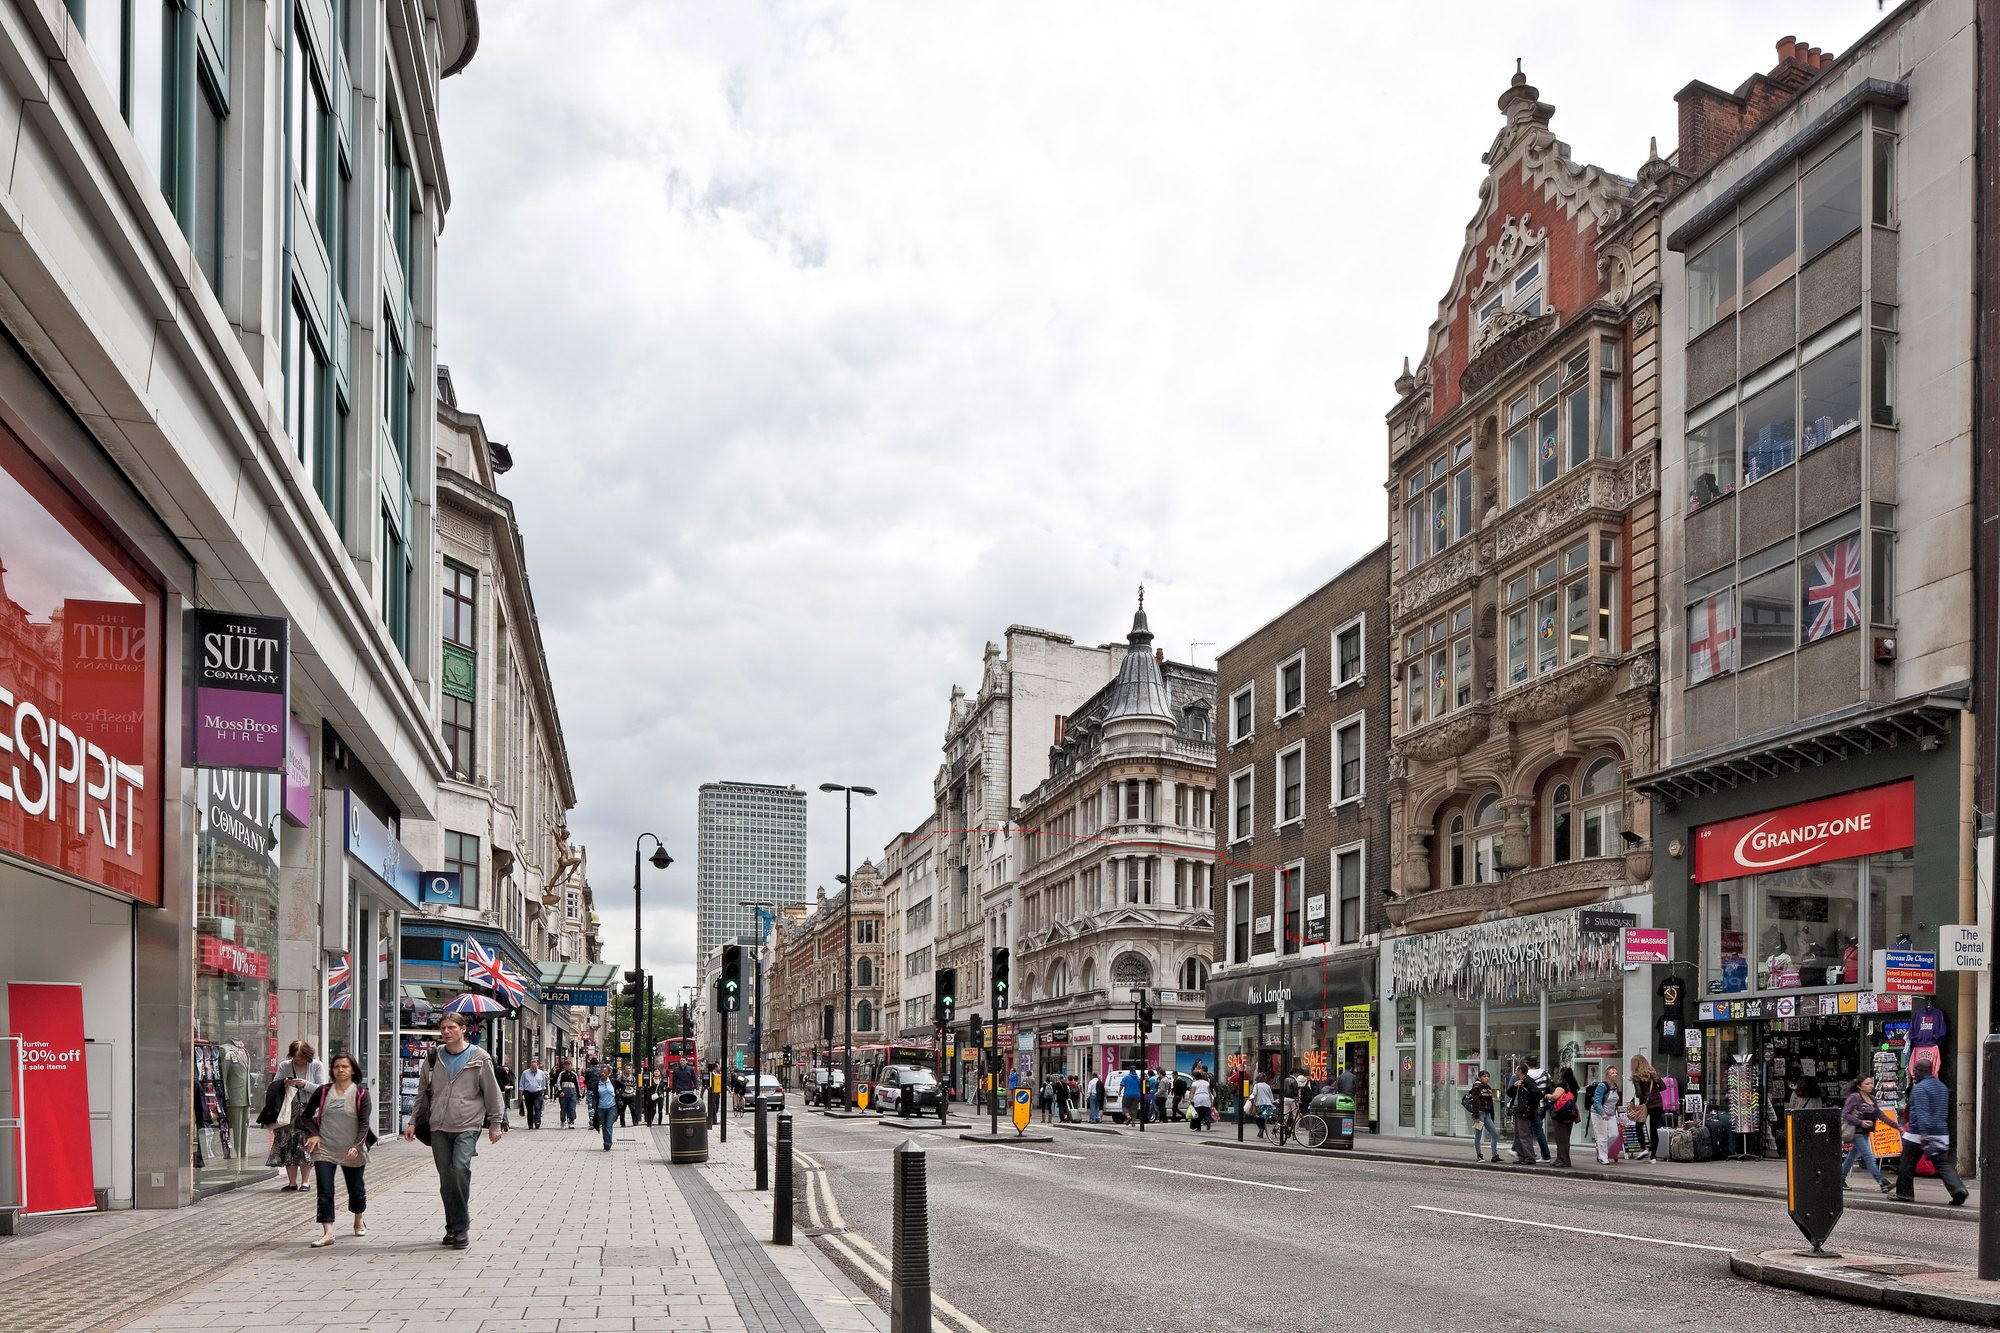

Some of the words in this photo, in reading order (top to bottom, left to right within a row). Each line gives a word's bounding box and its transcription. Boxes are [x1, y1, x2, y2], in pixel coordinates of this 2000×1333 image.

[226, 624, 257, 635] THE
[204, 632, 279, 674] SUIT
[203, 669, 280, 684] COMPANY
[204, 715, 278, 733] MossBros
[217, 730, 264, 743] HIRE
[211, 805, 266, 856] COMPANY
[1700, 830, 1712, 839] 149
[1751, 813, 1871, 851] GRANDZONE
[1594, 917, 1634, 927] SWAROVSKI
[1960, 929, 1979, 940] The
[1954, 941, 1984, 952] Dental
[1472, 940, 1550, 968] SWAROVSKI
[1886, 953, 1906, 961] Bureau
[1914, 955, 1934, 963] Change
[1956, 955, 1982, 966] Clinic
[232, 949, 249, 974] 70%
[541, 992, 570, 1001] PLAZA
[1248, 983, 1262, 1005] Miss
[1264, 980, 1291, 1003] London
[22, 1049, 57, 1063] 20%
[58, 1049, 81, 1062] off
[924, 1051, 934, 1059] 73
[1303, 1050, 1327, 1066] SALE
[1310, 1066, 1328, 1081] 50%
[1814, 1123, 1827, 1133] 23
